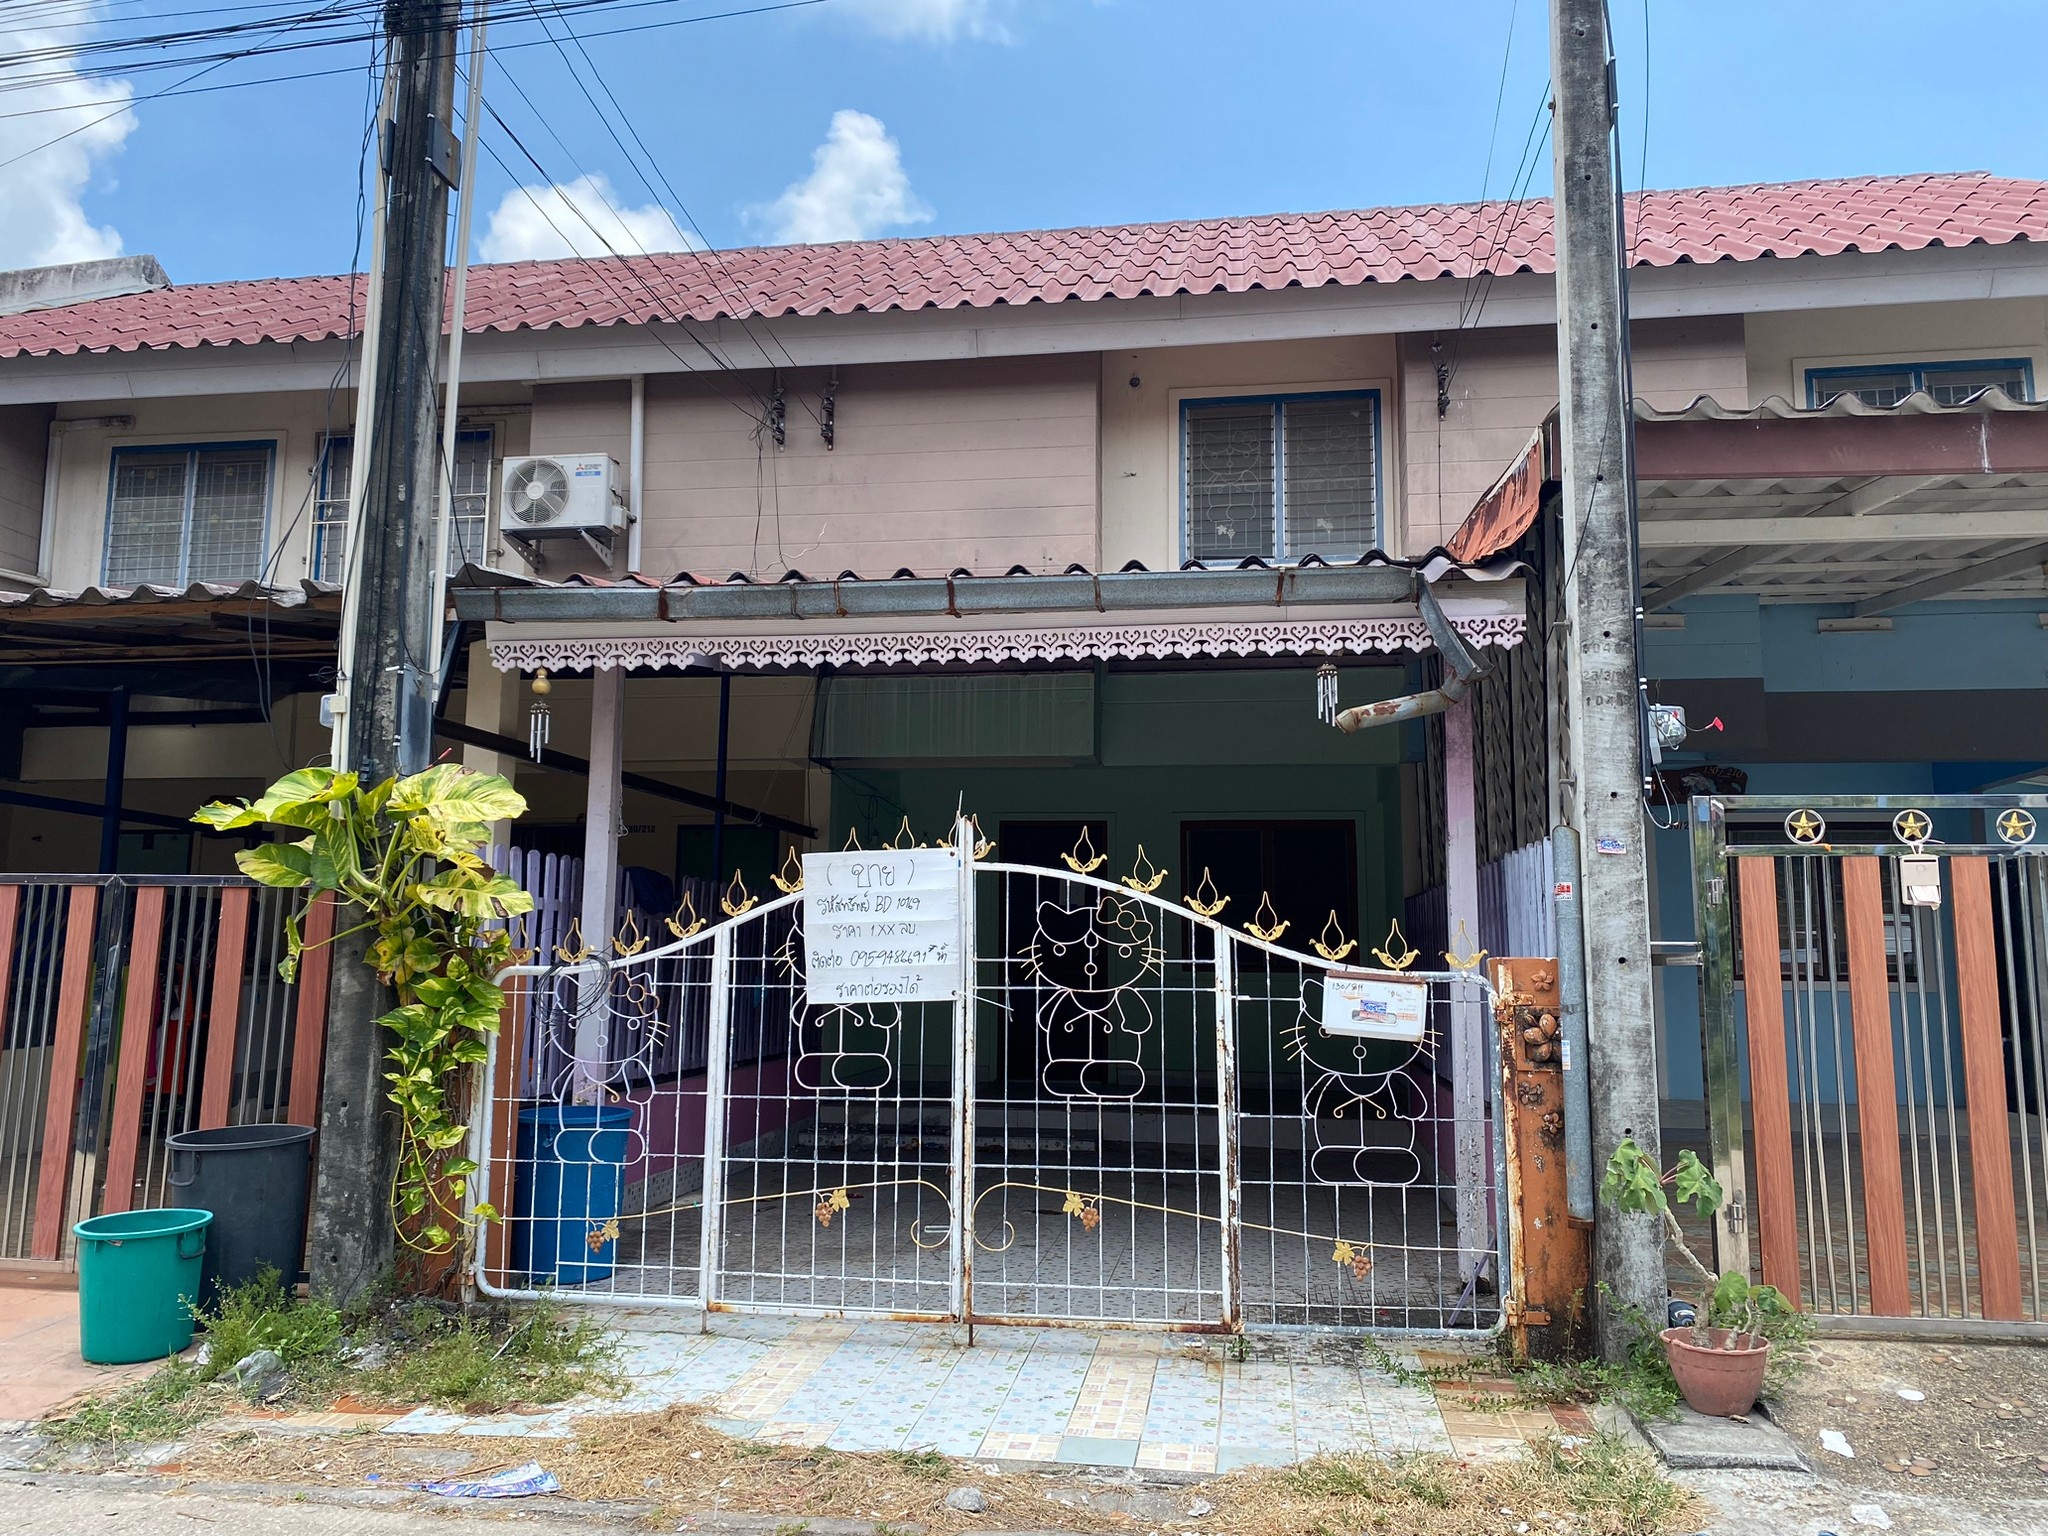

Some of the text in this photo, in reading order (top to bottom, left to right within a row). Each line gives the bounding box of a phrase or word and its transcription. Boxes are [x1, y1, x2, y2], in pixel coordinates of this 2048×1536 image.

[851, 863, 895, 888] ขาย
[874, 895, 893, 914] BD
[832, 924, 862, 939] ราคา
[811, 949, 843, 968] ติดต่อ
[836, 974, 923, 998] ราคาต่อรองได้
